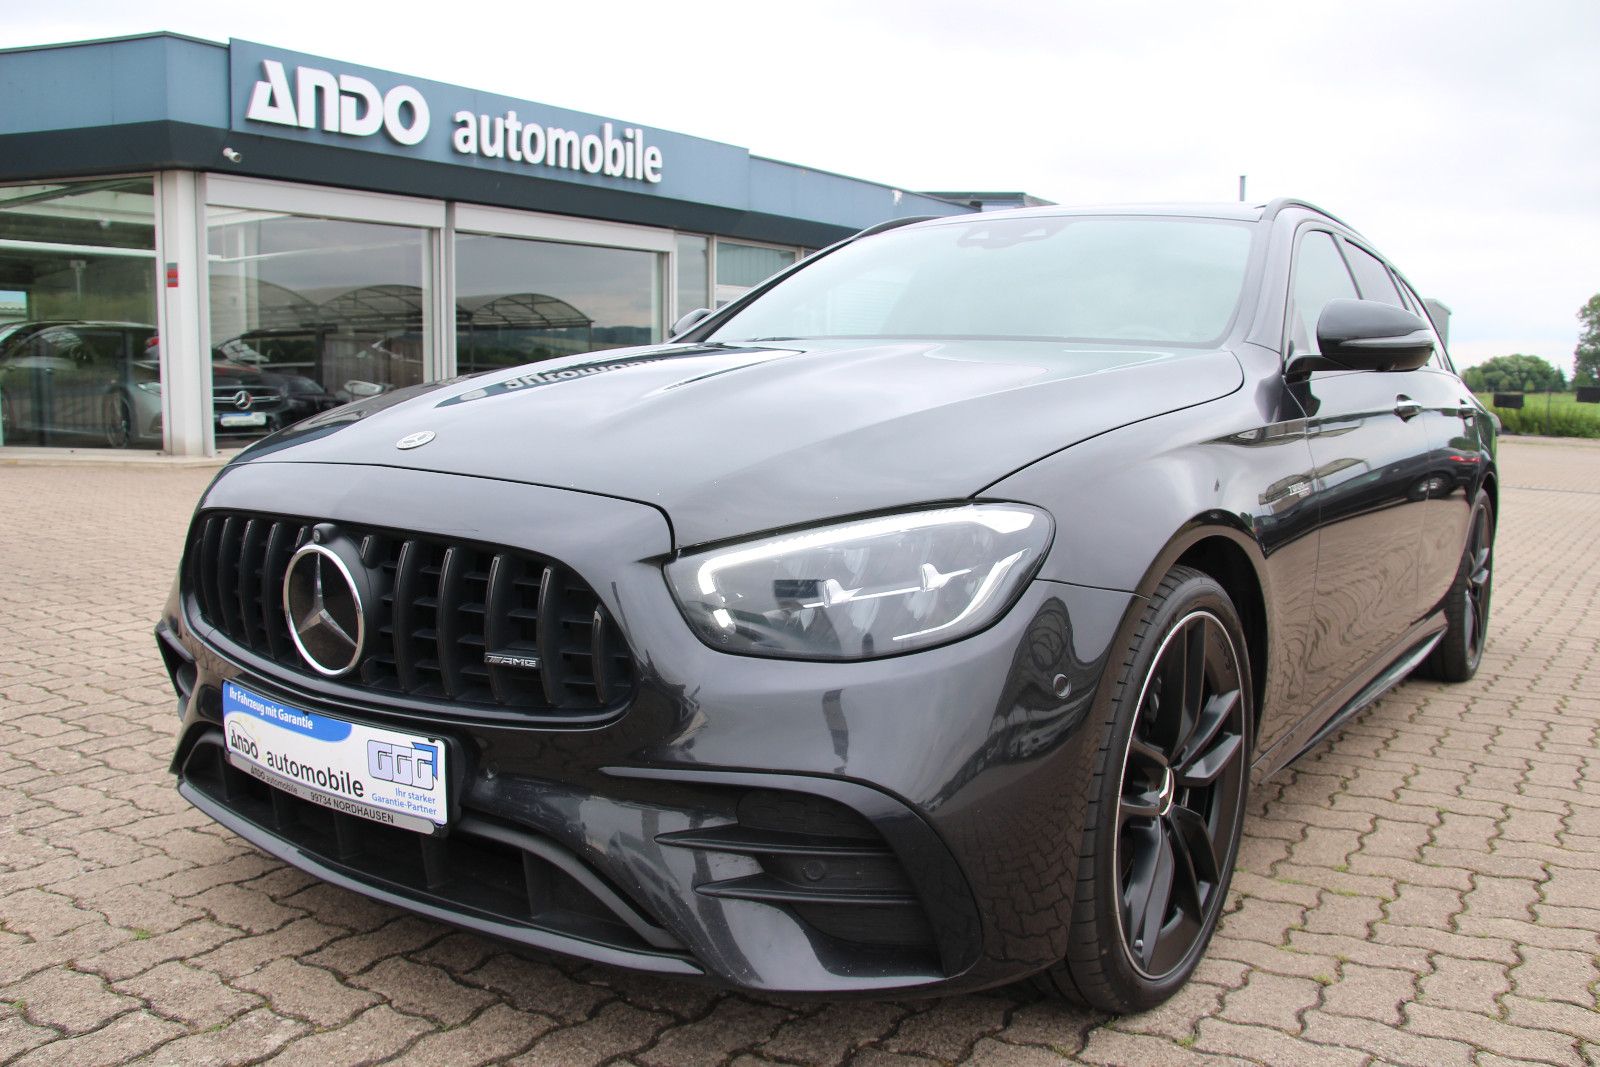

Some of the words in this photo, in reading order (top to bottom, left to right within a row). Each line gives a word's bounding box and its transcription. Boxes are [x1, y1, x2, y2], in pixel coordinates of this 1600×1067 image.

[245, 59, 430, 146] ANDO
[452, 110, 663, 183] automobile
[229, 686, 237, 700] Ihr
[237, 691, 264, 716] Fahrzeug
[265, 705, 277, 718] mit
[278, 709, 314, 729] Garantie
[231, 729, 259, 760] ANDO
[266, 750, 364, 798] automobile
[266, 775, 298, 795] automobile
[310, 791, 332, 806] 99734
[333, 799, 394, 824] NORDHAUSEN
[371, 792, 438, 816] Garantie-Partner
[395, 787, 406, 798] Ihr
[407, 789, 436, 804] starker
